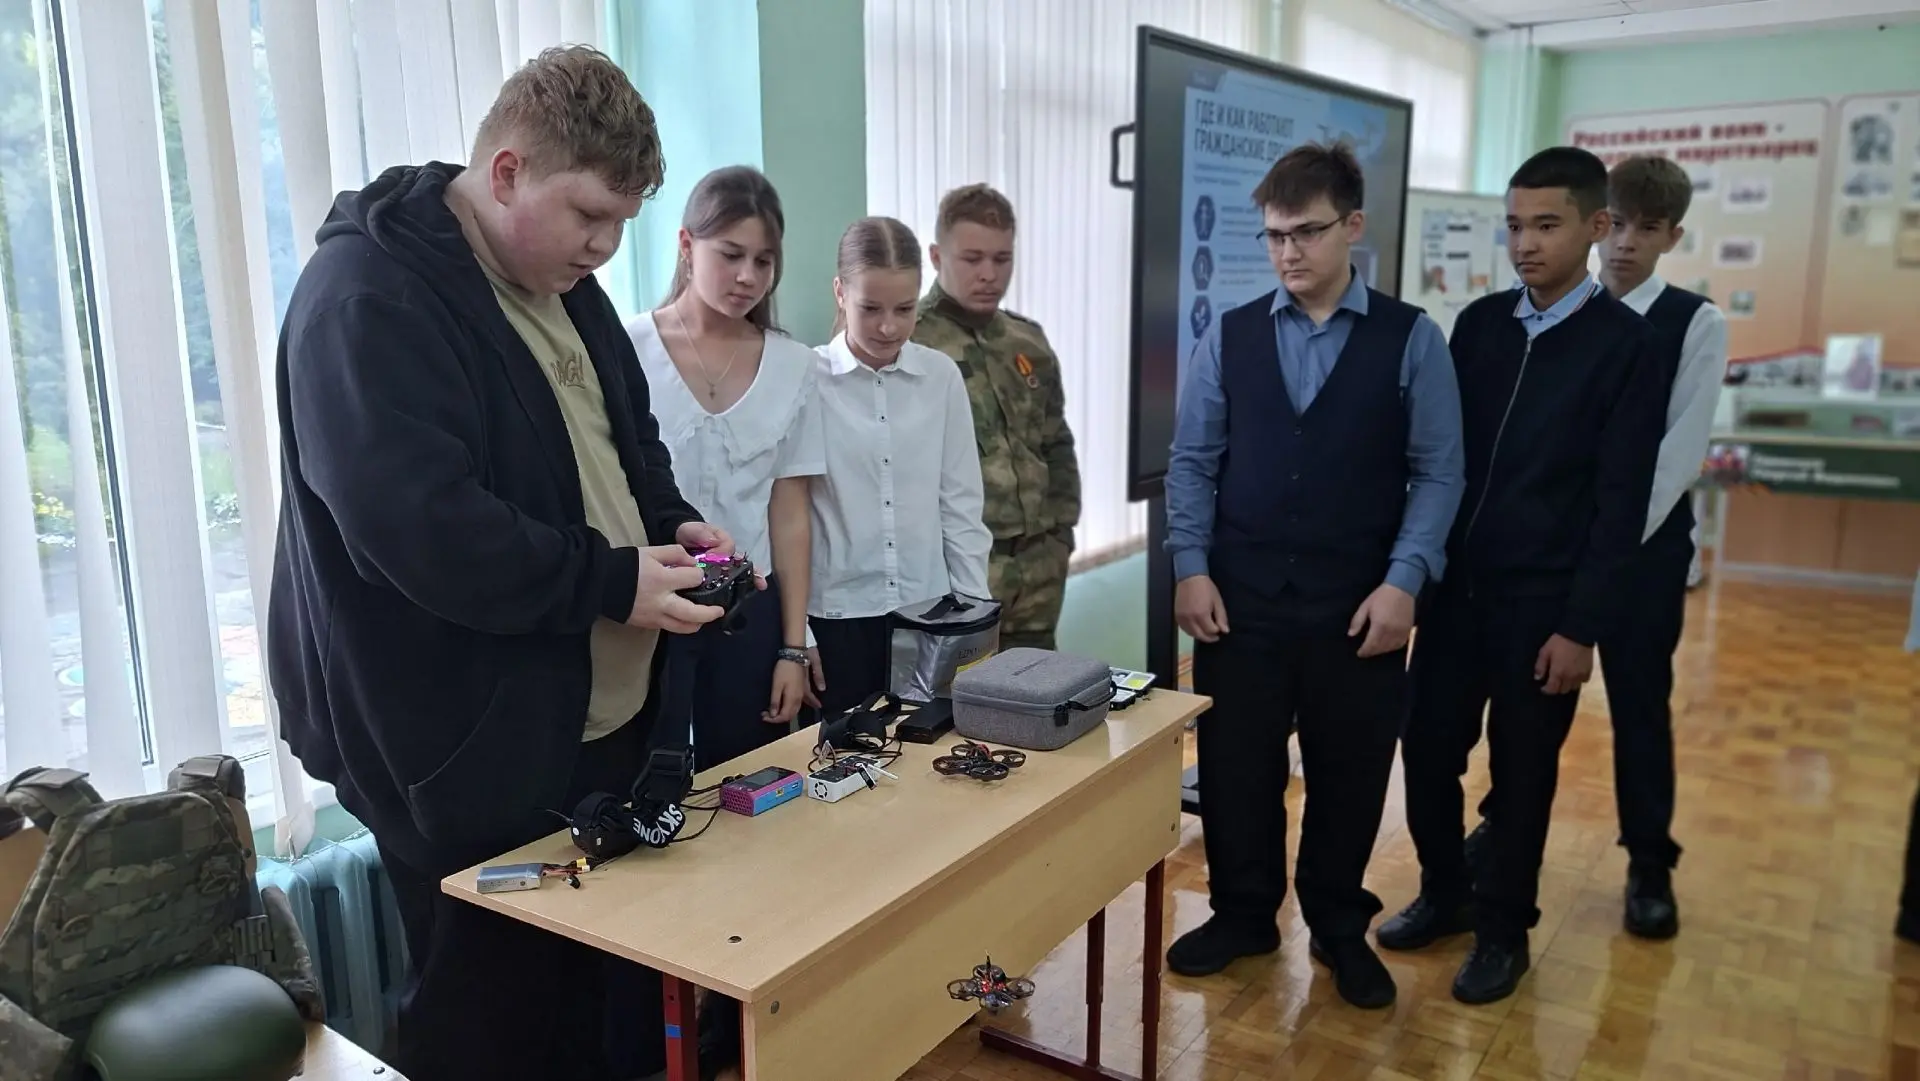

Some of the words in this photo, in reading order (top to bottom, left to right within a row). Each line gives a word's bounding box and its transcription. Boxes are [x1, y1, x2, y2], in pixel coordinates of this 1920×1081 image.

[1196, 98, 1214, 125] ГДЕ
[1217, 104, 1225, 123] И
[1226, 106, 1245, 129] КАК
[1248, 110, 1294, 139] РАБОТАЮТ
[1573, 126, 1702, 147] Российский
[1195, 128, 1264, 160] ГРАЖДАНСКИЕ
[633, 803, 683, 844] SKYONE
